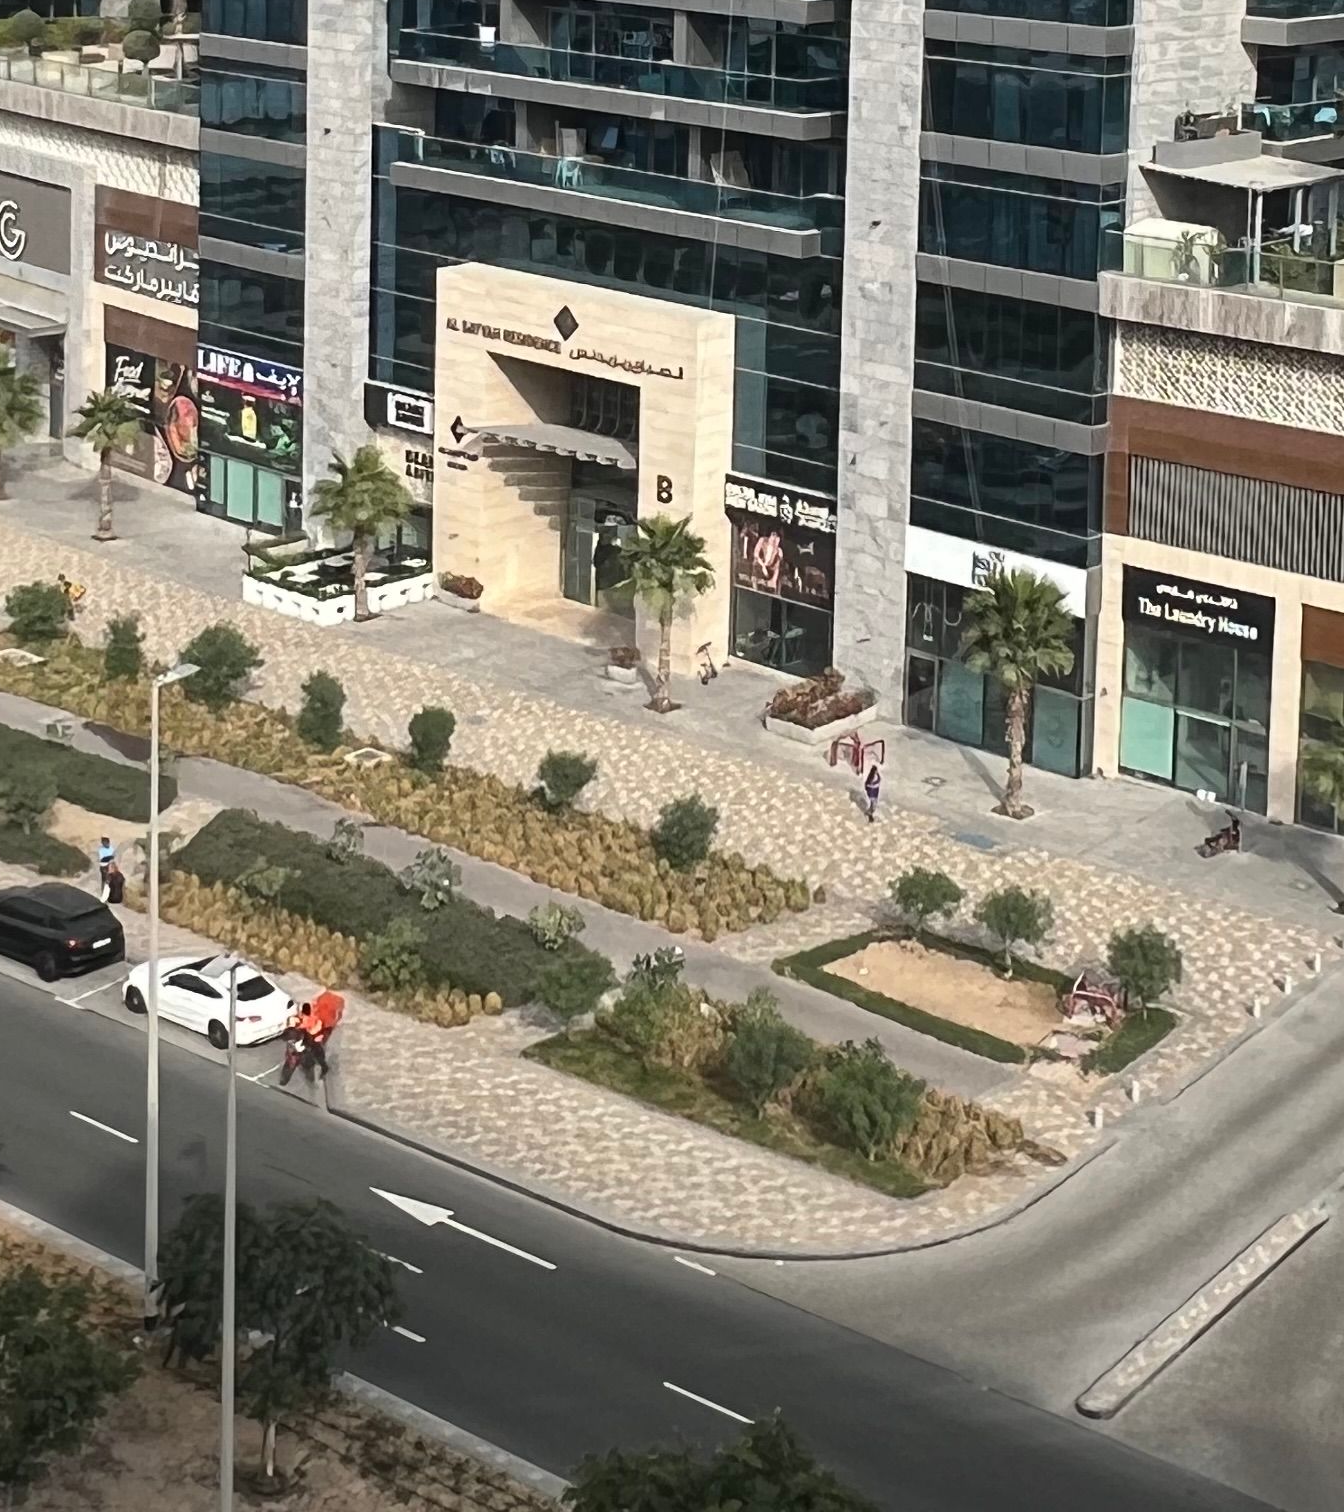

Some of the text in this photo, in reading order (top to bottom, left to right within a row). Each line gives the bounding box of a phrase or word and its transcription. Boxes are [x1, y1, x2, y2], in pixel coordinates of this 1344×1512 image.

[197, 349, 242, 379] LIFE
[656, 474, 673, 504] B
[1138, 596, 1162, 617] The
